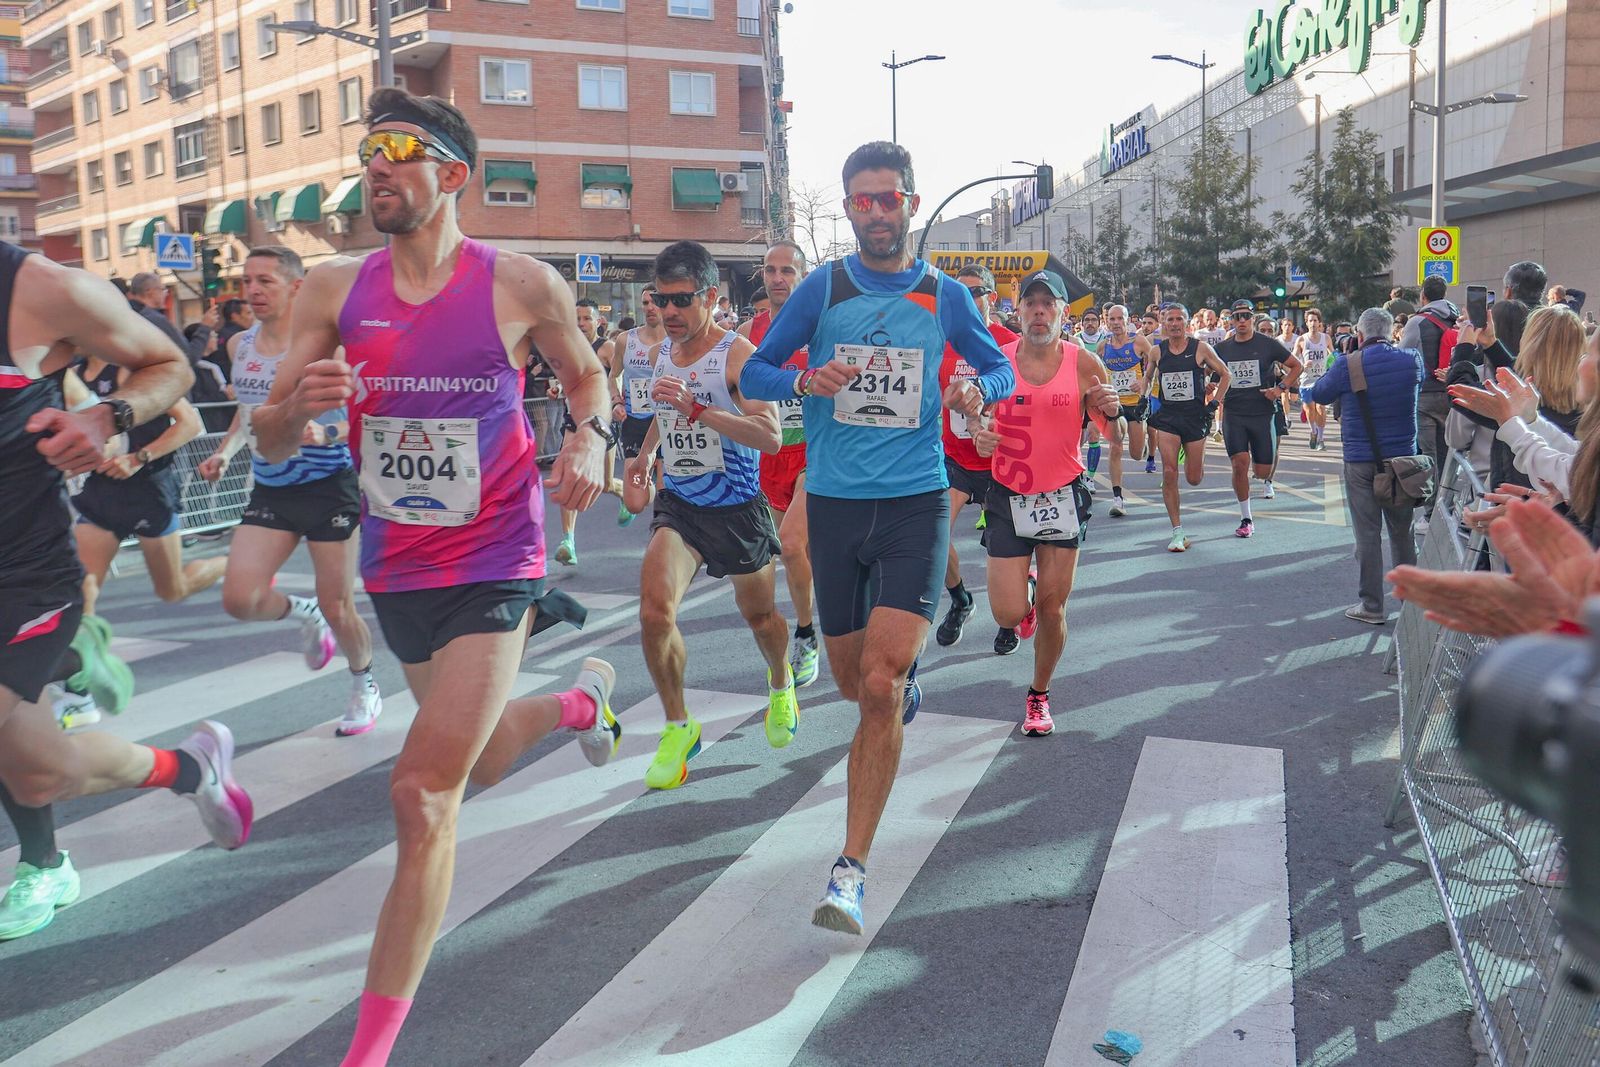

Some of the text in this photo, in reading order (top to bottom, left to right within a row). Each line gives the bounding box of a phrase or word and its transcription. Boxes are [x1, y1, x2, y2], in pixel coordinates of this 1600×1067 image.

[1431, 237, 1447, 247] 30
[935, 255, 1034, 271] MARCELINO
[1308, 351, 1324, 360] ENA
[1234, 369, 1254, 378] 1335
[235, 377, 273, 391] MARAC
[364, 376, 498, 393] TRITRAIN4YOU
[848, 372, 907, 395] 2314
[1115, 379, 1129, 387] 317
[1167, 381, 1188, 390] 2248
[637, 390, 648, 399] 31
[1052, 393, 1070, 407] BCC
[666, 433, 707, 449] 1615
[996, 394, 1034, 494] SUR
[380, 452, 457, 481] 2004
[1029, 506, 1060, 523] 123
